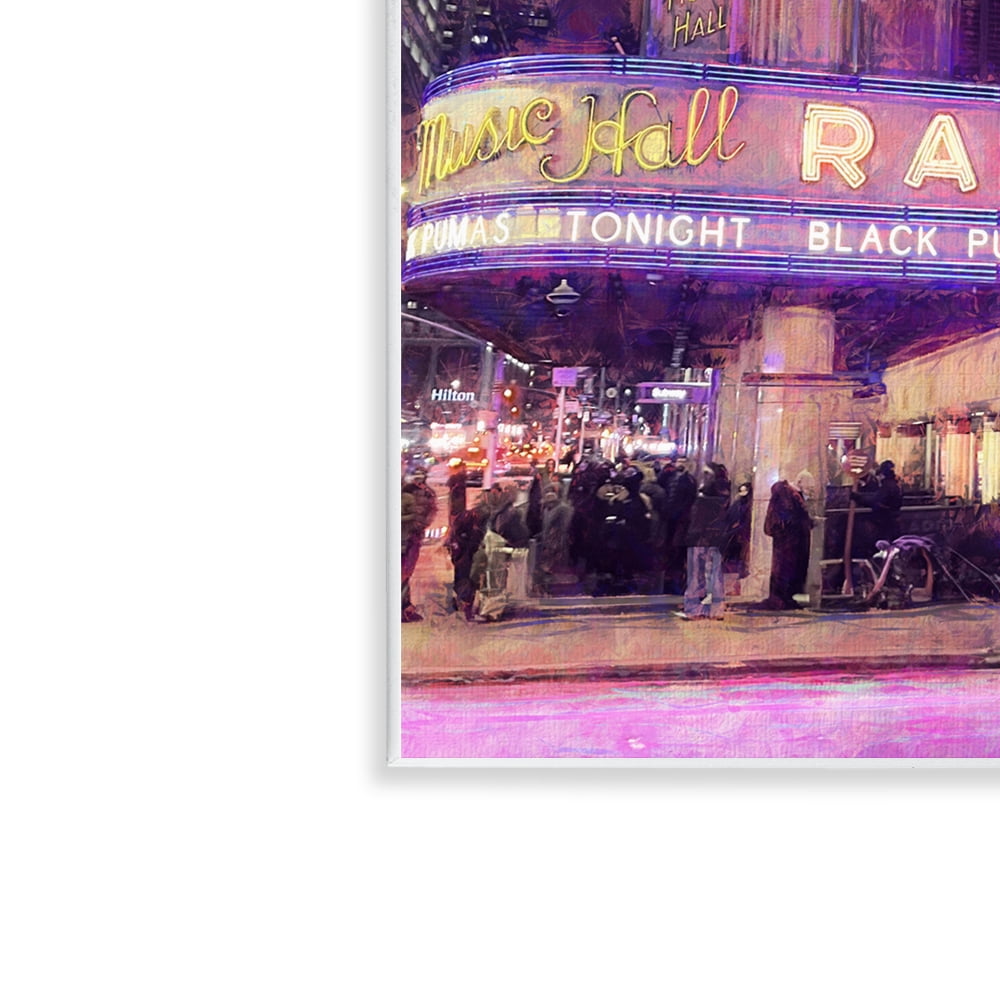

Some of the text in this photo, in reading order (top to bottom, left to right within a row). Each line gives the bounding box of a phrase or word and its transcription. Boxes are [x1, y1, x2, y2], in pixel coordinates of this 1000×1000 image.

[672, 6, 727, 48] HALL
[539, 85, 747, 183] Hall
[419, 212, 511, 254] PUMAS
[566, 210, 752, 249] TONIGHT
[807, 222, 939, 257] BLACK
[431, 388, 475, 402] Hilton
